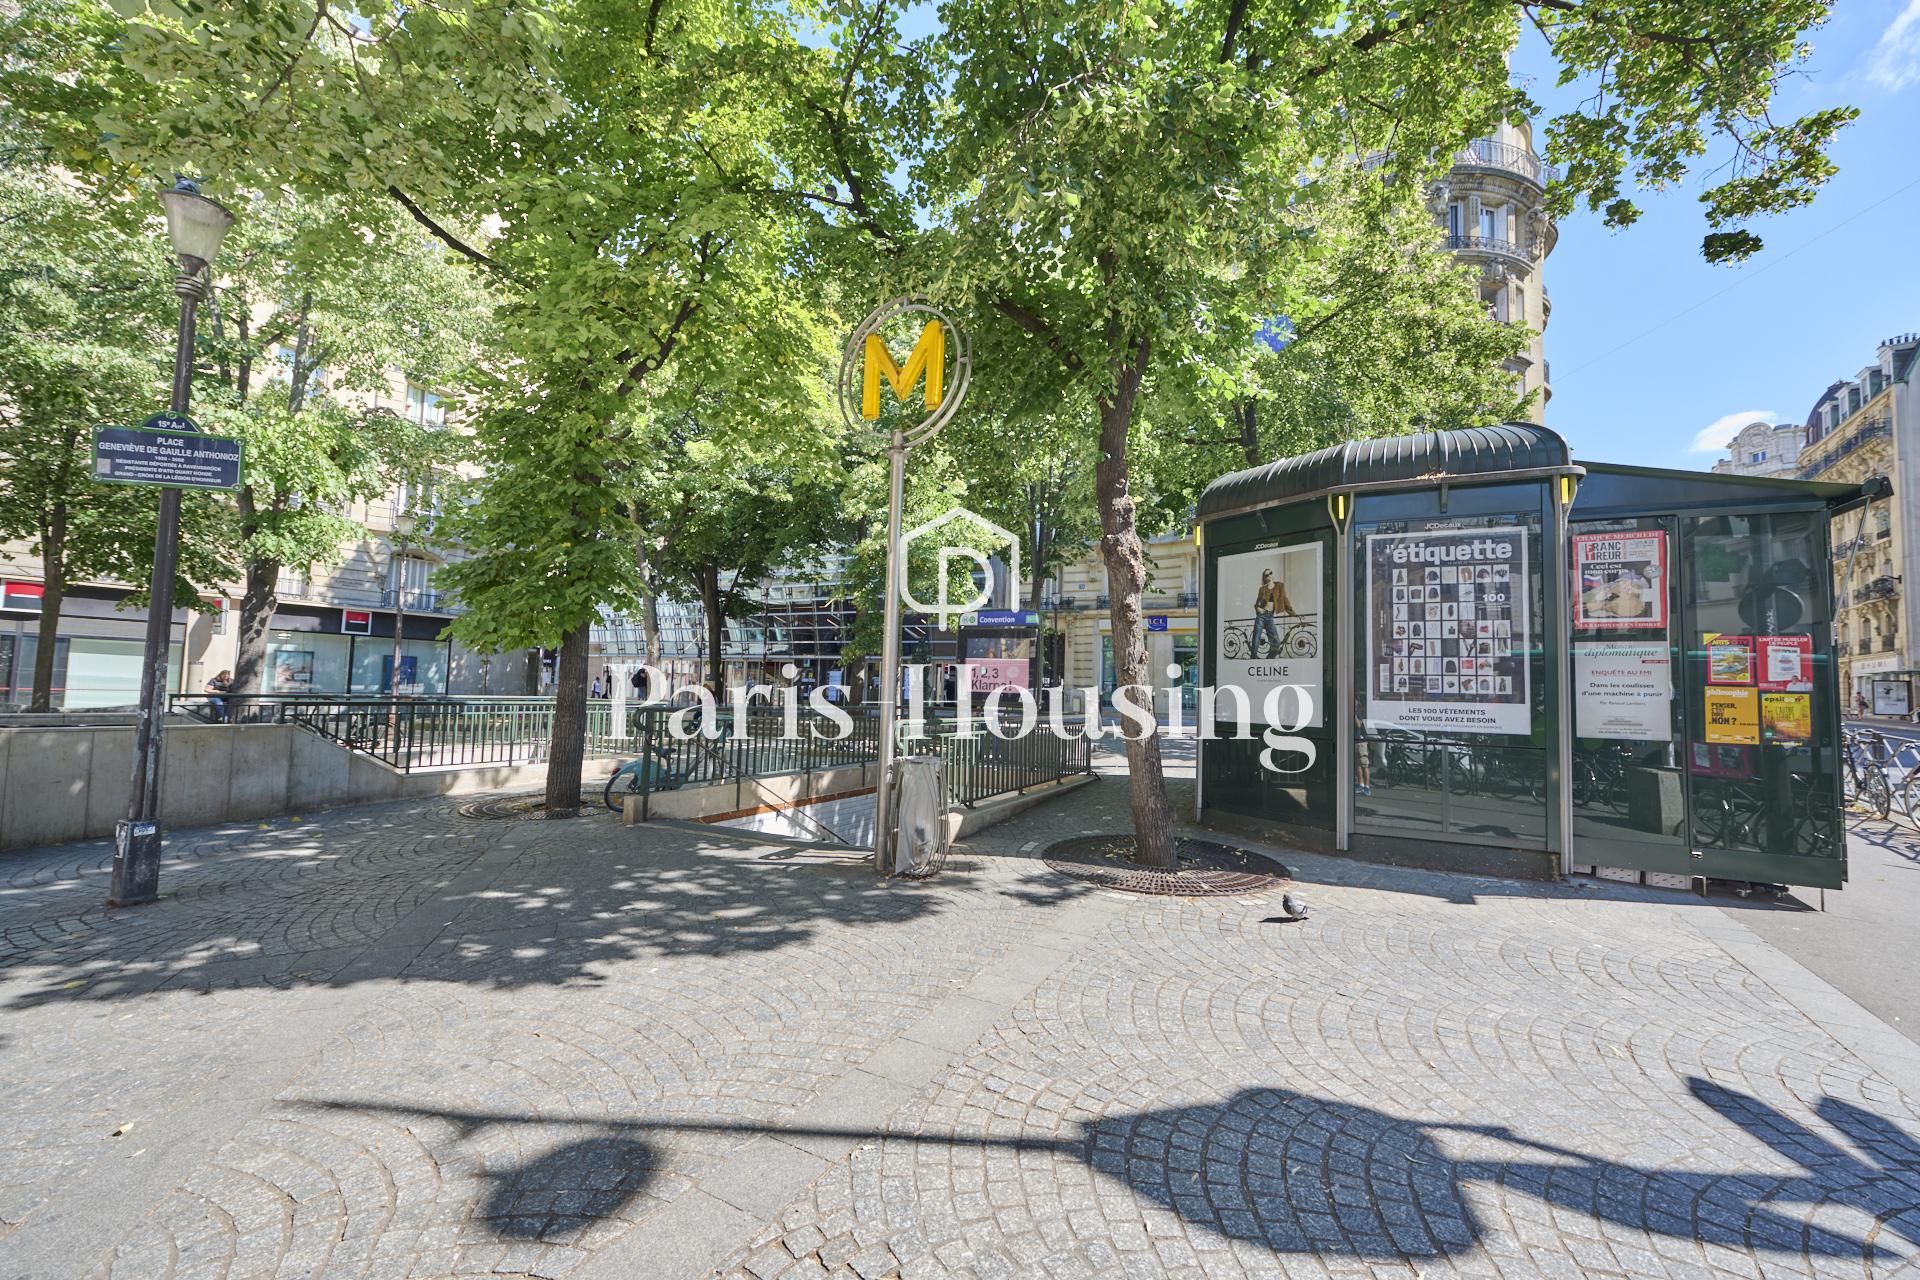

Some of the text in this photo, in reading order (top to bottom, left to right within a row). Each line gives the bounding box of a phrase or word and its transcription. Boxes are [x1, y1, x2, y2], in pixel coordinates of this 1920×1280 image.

[862, 319, 945, 421] M
[157, 437, 185, 447] PLACE
[98, 442, 239, 462] GENEVIÈVE DE GAULLE ANTHONIOZ
[1424, 521, 1465, 530] JCDecaux
[1585, 541, 1621, 552] FRANC
[1482, 593, 1506, 602] 100
[979, 616, 1016, 624] Convention
[1584, 647, 1659, 659] diplomatique
[1247, 666, 1289, 677] CELINE
[1438, 707, 1486, 716] VÊTEMENTS
[1711, 717, 1730, 725] NON
[1731, 717, 1737, 725] ?
